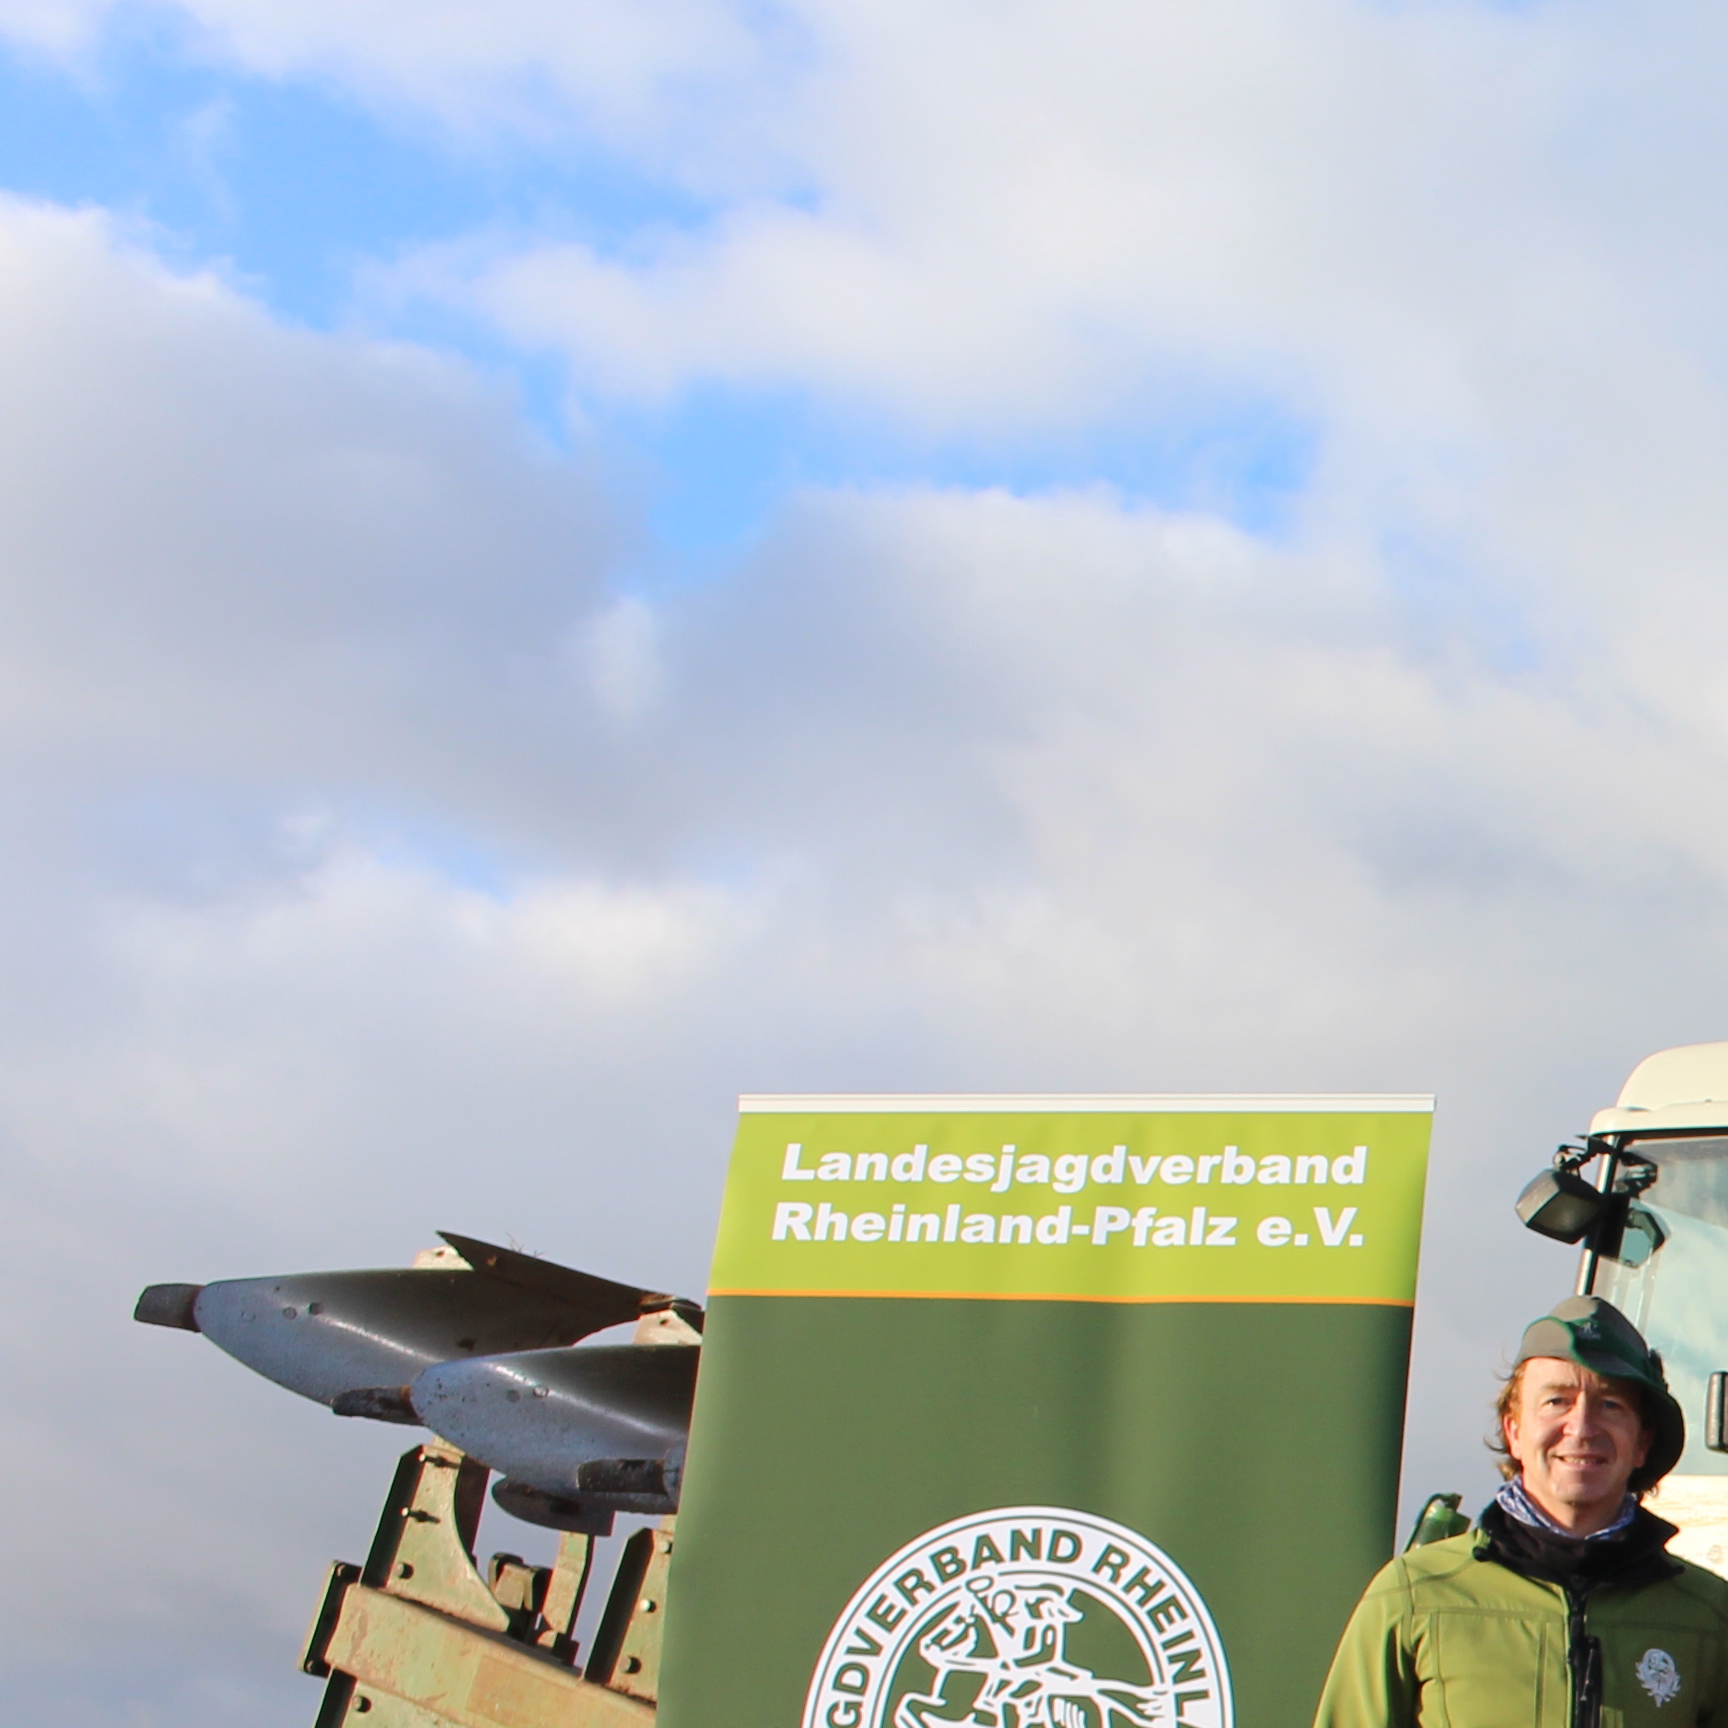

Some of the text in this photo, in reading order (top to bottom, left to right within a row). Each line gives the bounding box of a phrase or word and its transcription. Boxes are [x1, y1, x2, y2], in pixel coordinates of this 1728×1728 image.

[781, 1142, 1368, 1193] Landesjagdverband
[771, 1202, 1365, 1246] Rheinland-Pfalz e.V.
